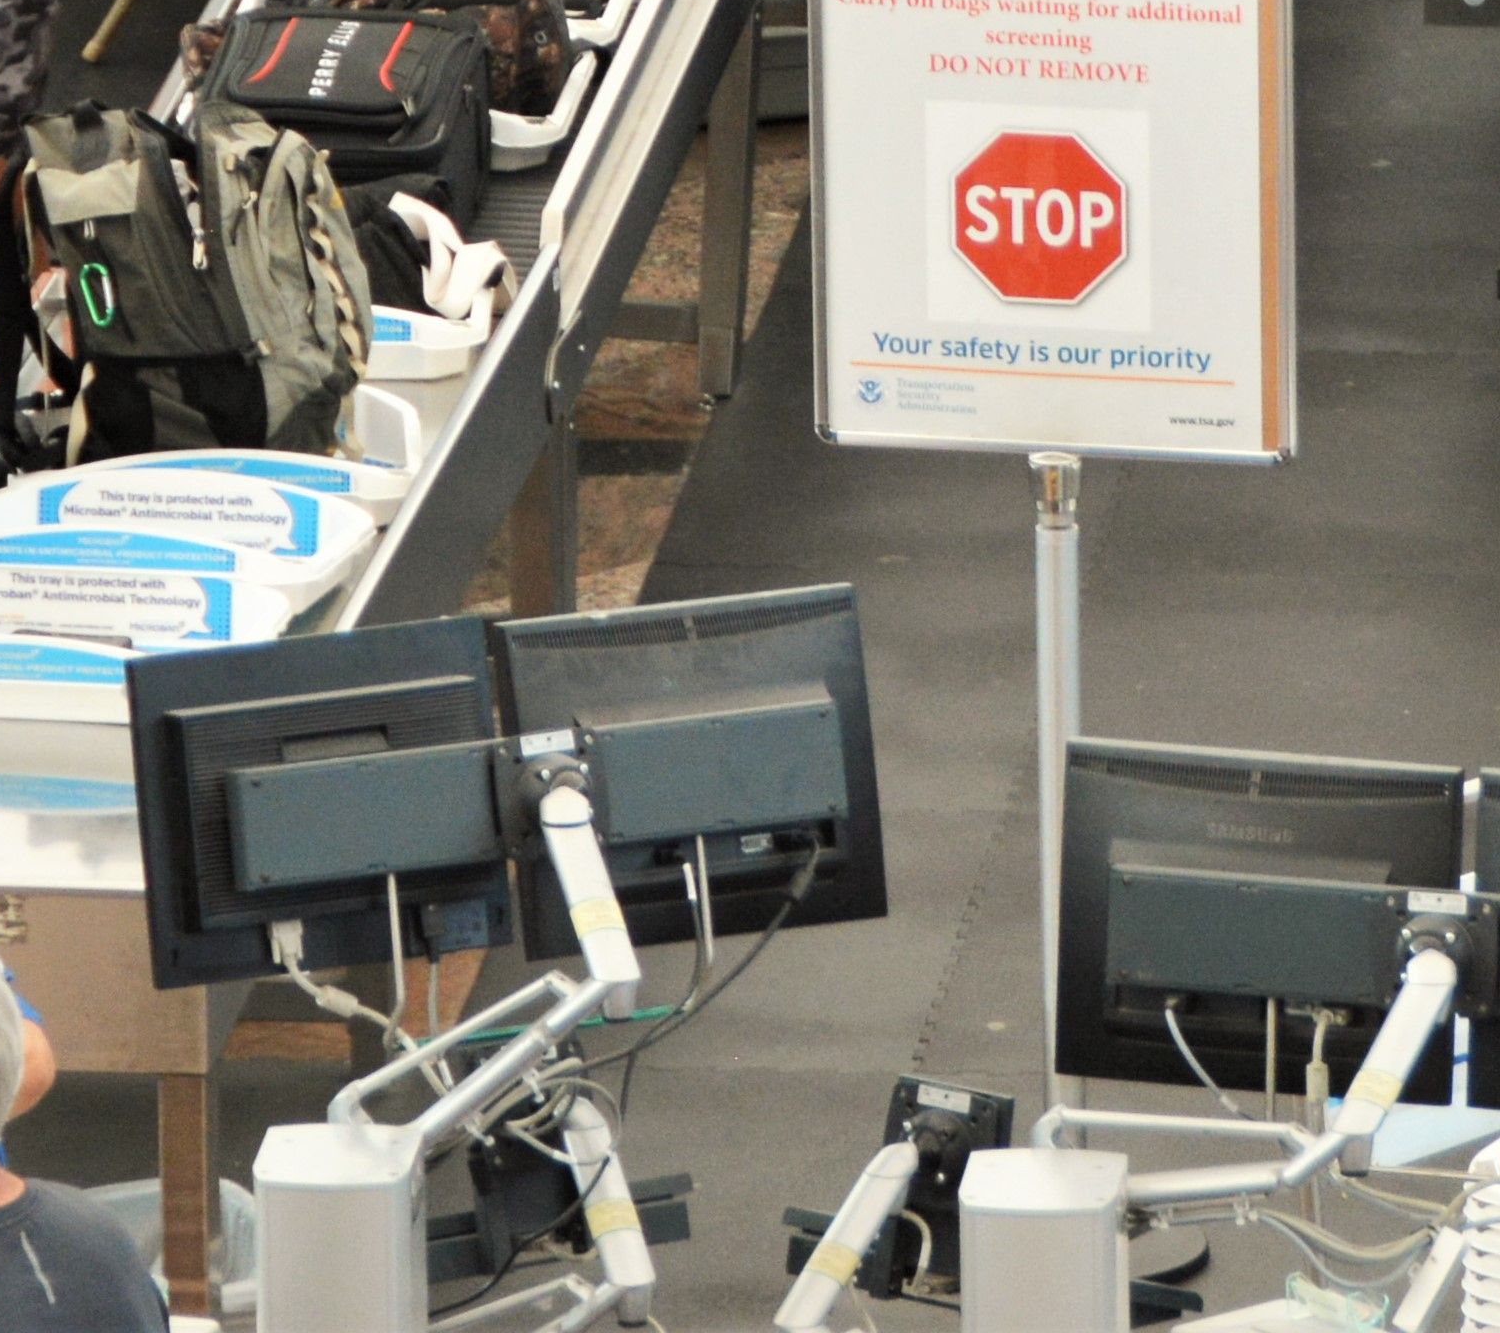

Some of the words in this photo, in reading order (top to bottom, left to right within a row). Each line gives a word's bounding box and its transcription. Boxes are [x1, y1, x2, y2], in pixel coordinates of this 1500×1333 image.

[1126, 3, 1243, 25] additional
[984, 28, 1094, 54] screening
[308, 48, 343, 98] PERRY
[327, 20, 362, 47] ELLIS
[928, 53, 969, 74] DO
[975, 56, 1032, 78] NOT
[1039, 58, 1150, 85] REMOVE
[964, 184, 1115, 249] STOP
[872, 332, 934, 356] Your
[939, 336, 1022, 364] safety
[1029, 339, 1050, 362] is
[1057, 346, 1103, 365] our
[1109, 345, 1212, 374] priority
[896, 376, 975, 394] Transportation
[896, 389, 941, 403] Security
[896, 400, 978, 415] Administration
[1168, 414, 1236, 428] www.tsa.gov
[99, 489, 127, 503] This
[128, 491, 150, 505] tray
[153, 493, 163, 504] is
[165, 493, 225, 508] protected
[226, 495, 253, 508] with
[130, 507, 213, 522] Antimicrobial
[216, 510, 288, 526] Technology
[11, 571, 37, 584] This
[39, 574, 63, 588] tray
[64, 575, 75, 586] is
[77, 575, 138, 589] protected
[140, 578, 166, 590] with
[41, 589, 126, 604] Antimicrobial
[129, 593, 201, 609] Technology
[1206, 823, 1294, 843] SAMSUNG
